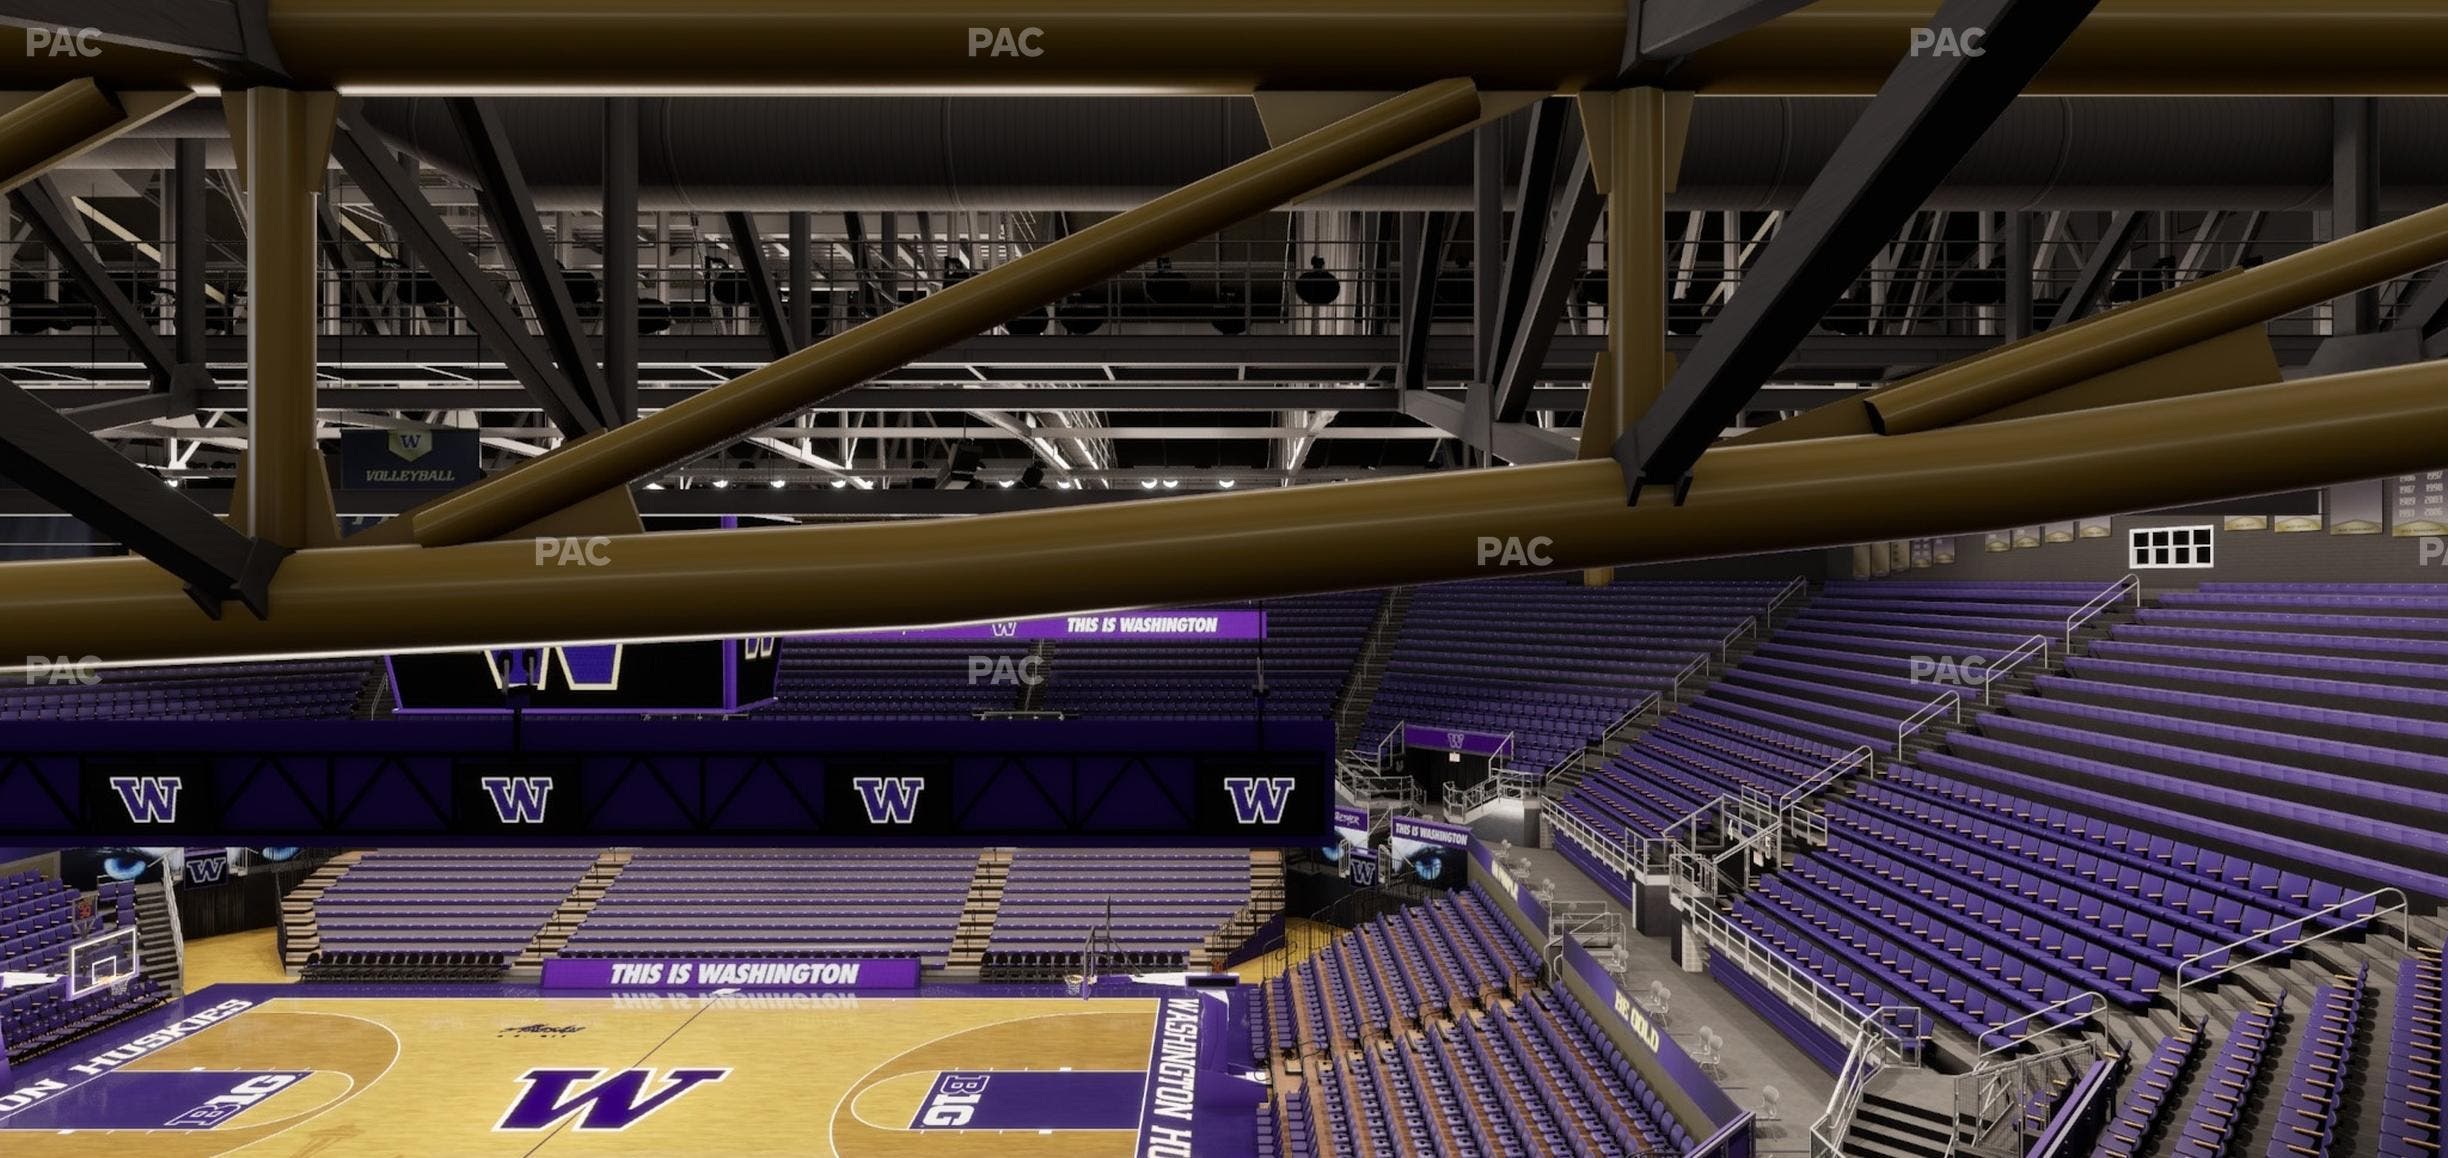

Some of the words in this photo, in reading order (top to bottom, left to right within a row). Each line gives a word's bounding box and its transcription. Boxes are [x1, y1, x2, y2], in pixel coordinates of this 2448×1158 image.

[400, 434, 421, 449] W
[366, 469, 455, 482] VOLLEYBALL
[1067, 617, 1099, 633] THIS
[1101, 617, 1117, 633] IS
[1119, 617, 1219, 633] WASHINGTON
[110, 776, 181, 823] W
[482, 776, 553, 823] W
[853, 776, 924, 823] W
[1224, 776, 1295, 823] W
[1395, 823, 1411, 836] THIS
[1412, 826, 1419, 837] IS
[1420, 827, 1469, 846] WASHINGTON
[186, 856, 227, 883] W
[1351, 858, 1376, 886] W
[611, 963, 664, 984] THIS
[667, 963, 693, 984] IS
[698, 963, 860, 984] WASHINGTON
[69, 998, 254, 1076] HUSKIES
[1153, 998, 1199, 1121] WASHINGTON
[491, 1067, 734, 1132] W
